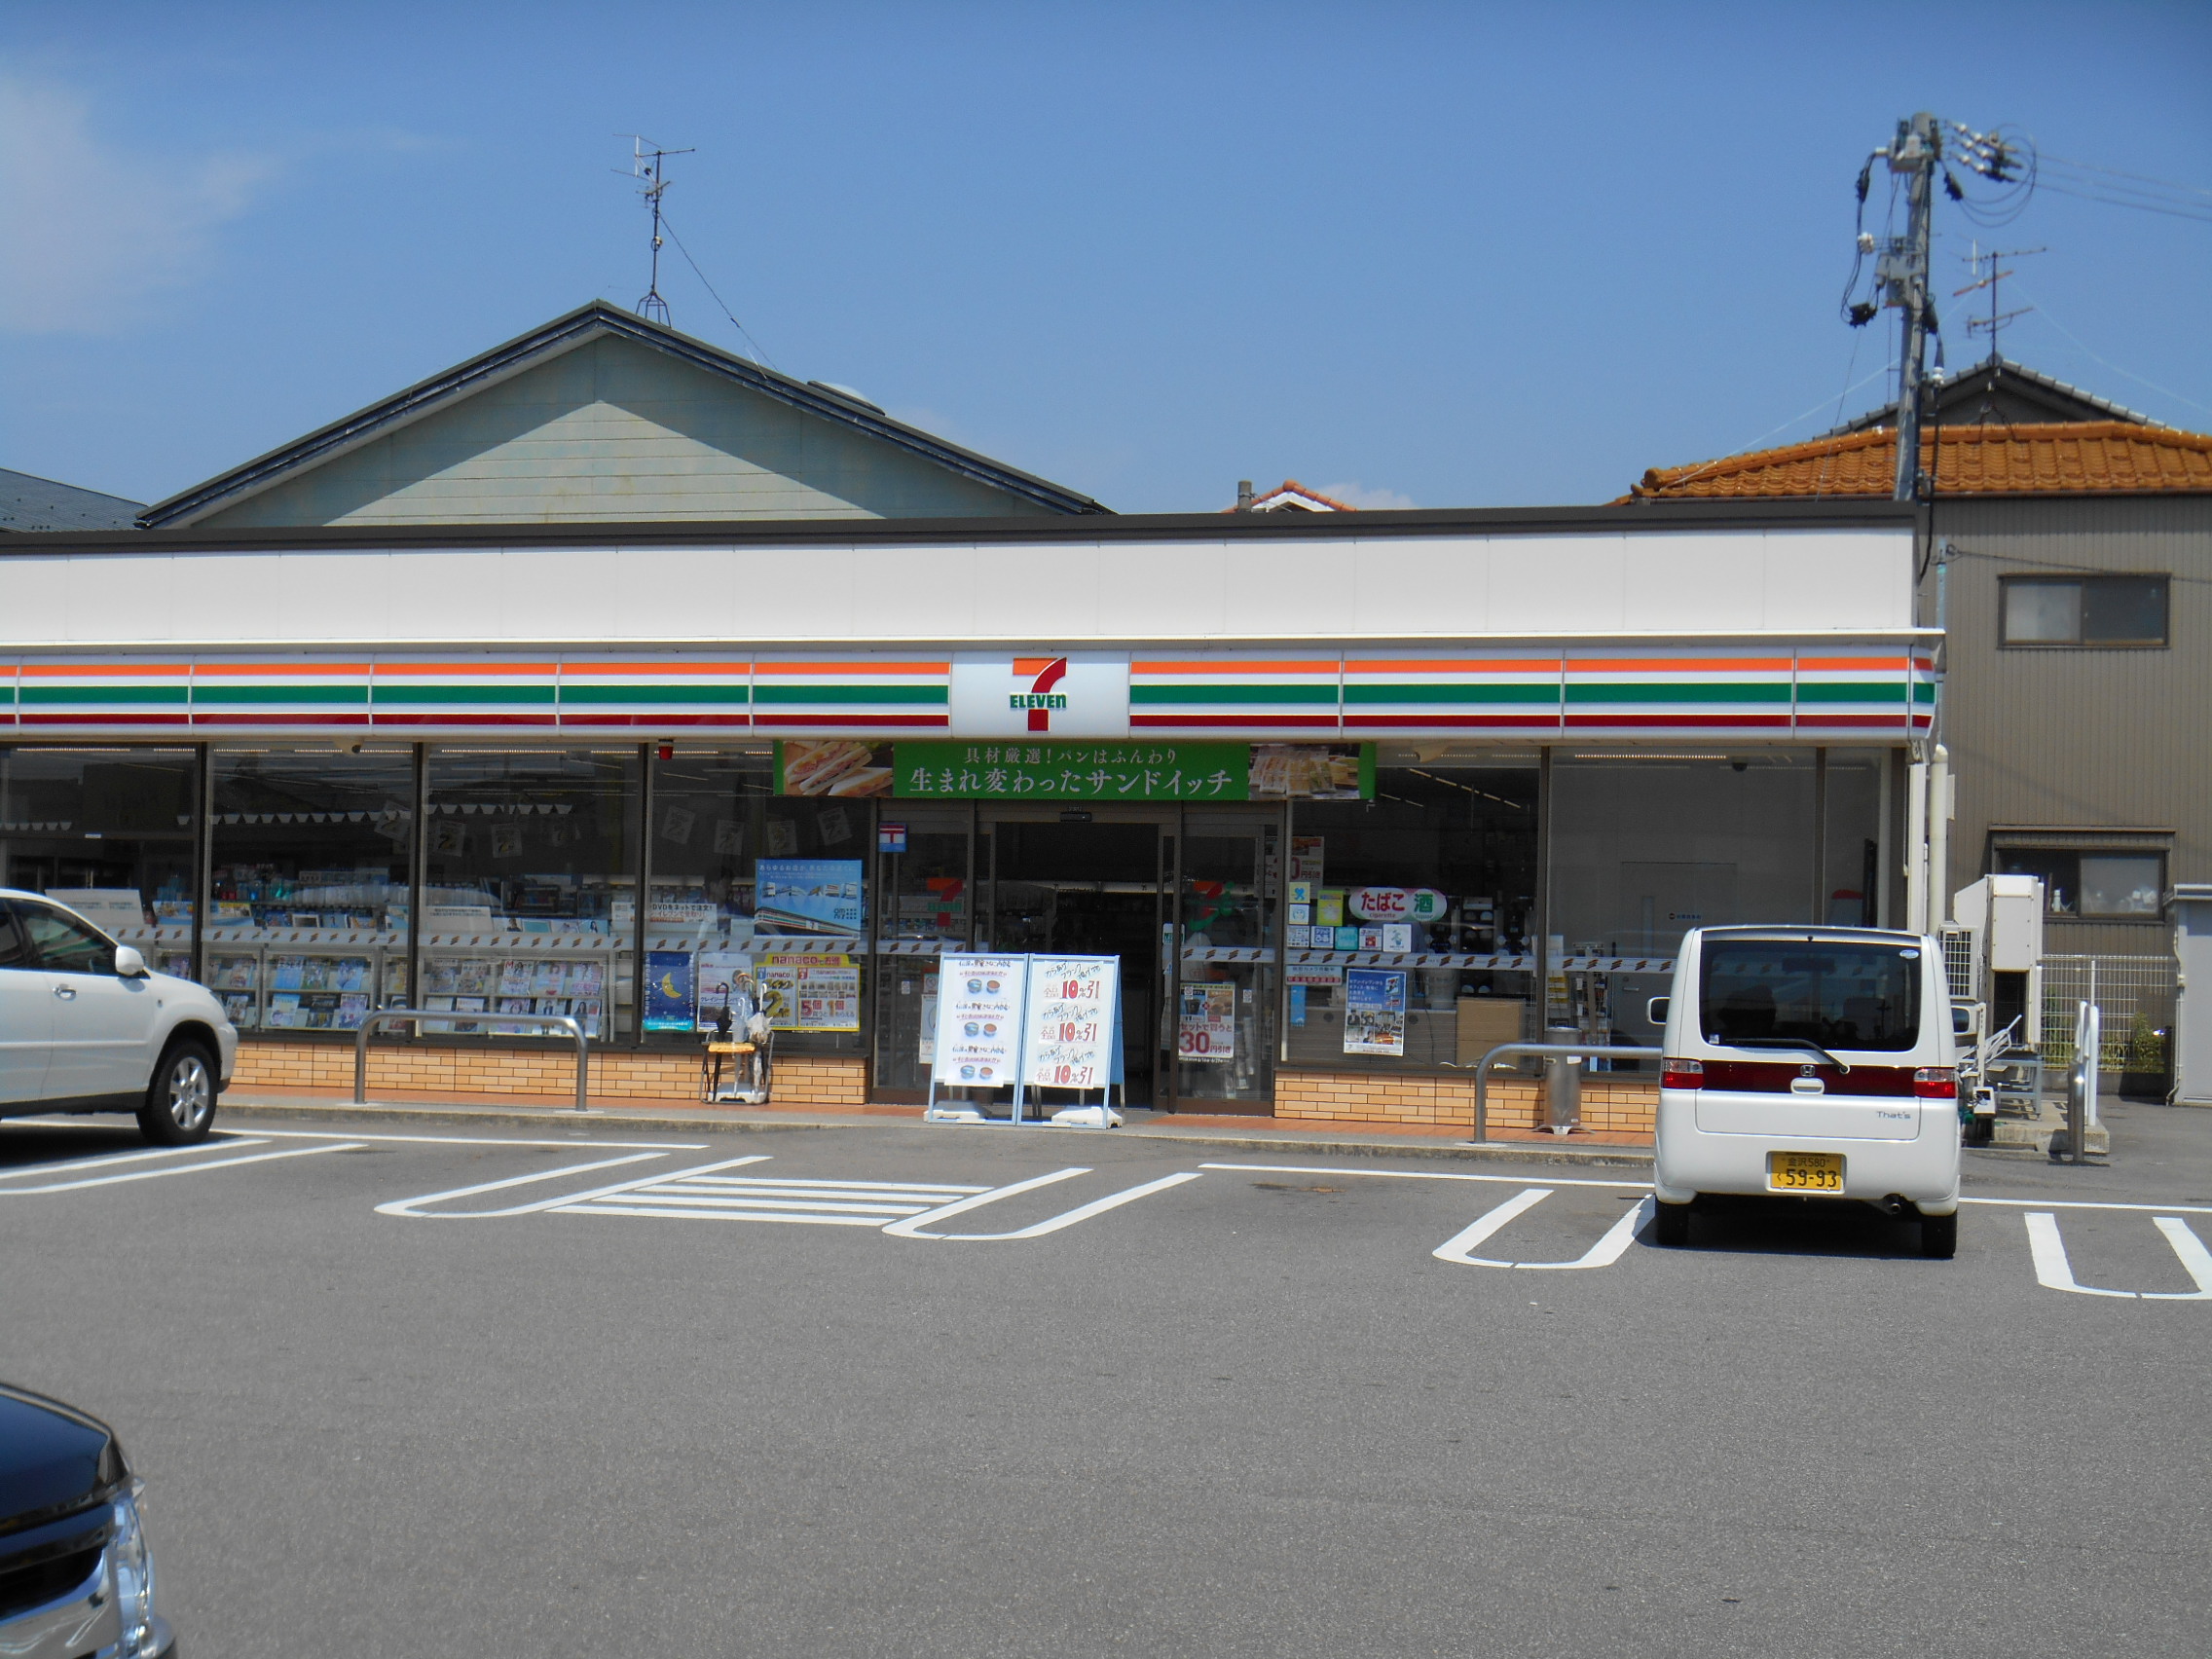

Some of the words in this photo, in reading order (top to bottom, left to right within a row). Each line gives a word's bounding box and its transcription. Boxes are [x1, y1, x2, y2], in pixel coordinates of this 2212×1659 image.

[909, 767, 1234, 797] 生まれ変わったサンドイッチ
[1361, 892, 1406, 911] たばこ
[1414, 893, 1434, 913] 酒
[1181, 1022, 1233, 1032] セットで買うと
[1876, 1110, 1911, 1120] That's
[1786, 1168, 1837, 1188] 59-93
